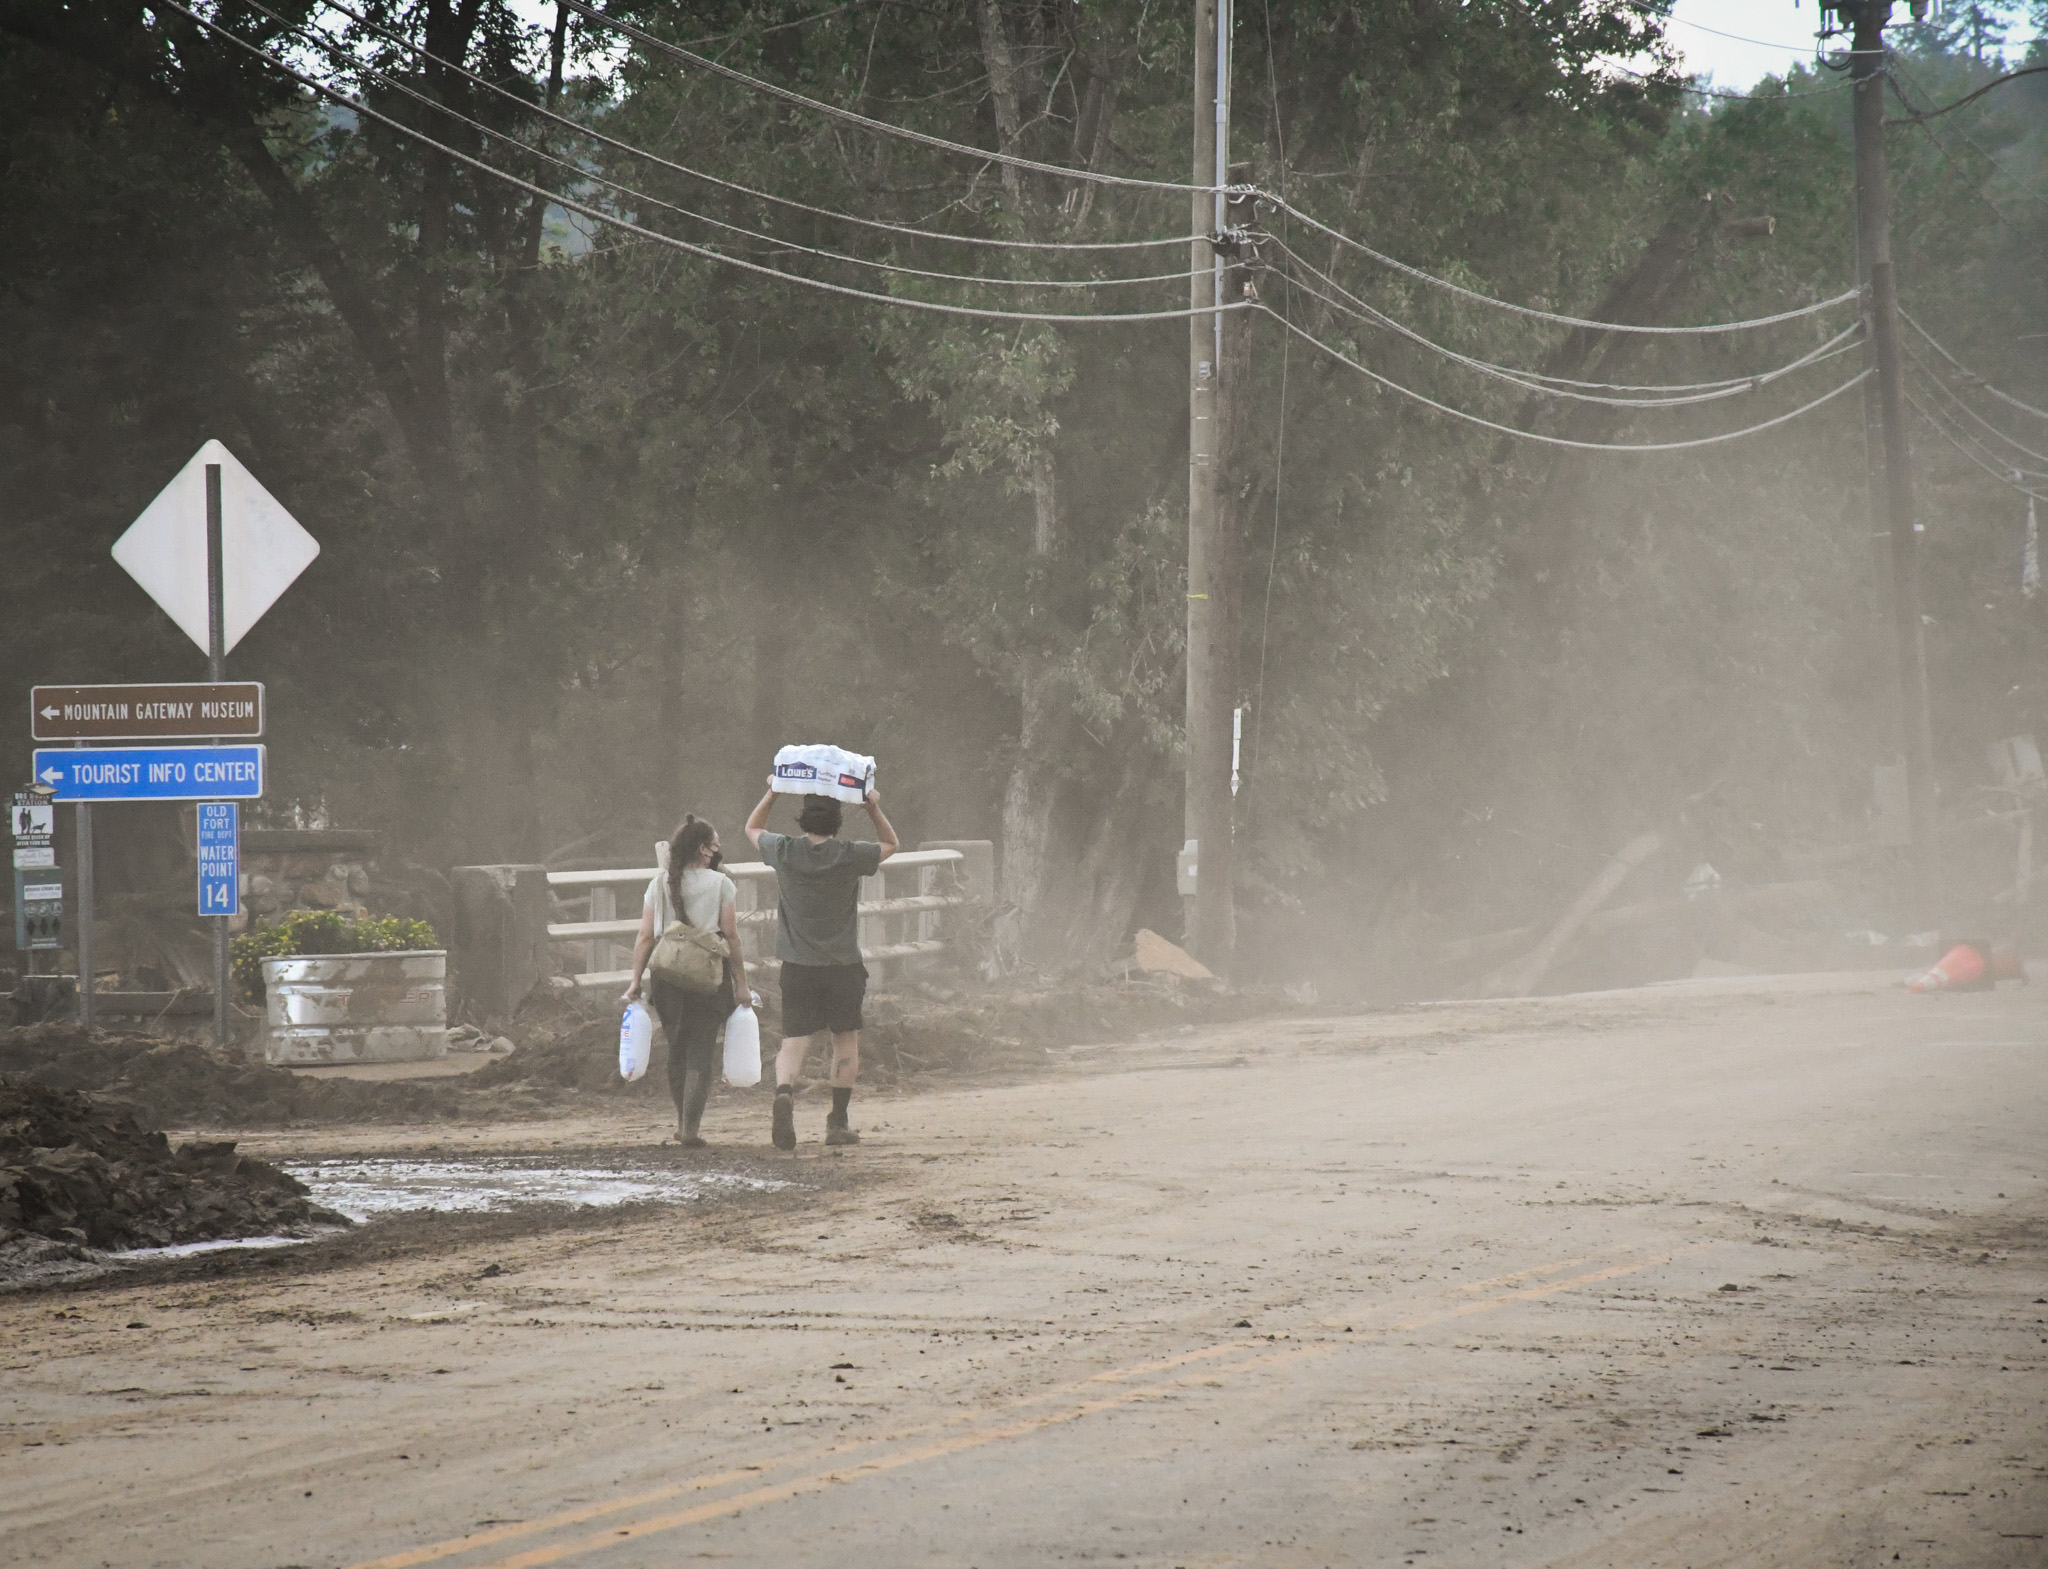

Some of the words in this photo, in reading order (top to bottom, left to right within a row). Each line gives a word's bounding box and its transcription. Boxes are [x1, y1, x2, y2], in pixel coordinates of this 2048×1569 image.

[64, 704, 129, 720] MOUNTAIN
[136, 703, 193, 719] GATEWAY
[201, 702, 254, 718] MUSEUM
[72, 764, 140, 784] TOURIST
[149, 763, 186, 782] INFO
[194, 762, 256, 782] CENTER
[782, 767, 813, 778] LOWE'S
[206, 806, 227, 817] OLD
[203, 818, 230, 830] FORT
[201, 831, 214, 839] FIRE
[200, 846, 234, 861] WATER
[201, 862, 233, 877] POINT
[206, 884, 229, 908] 14
[338, 992, 430, 1006] TER
